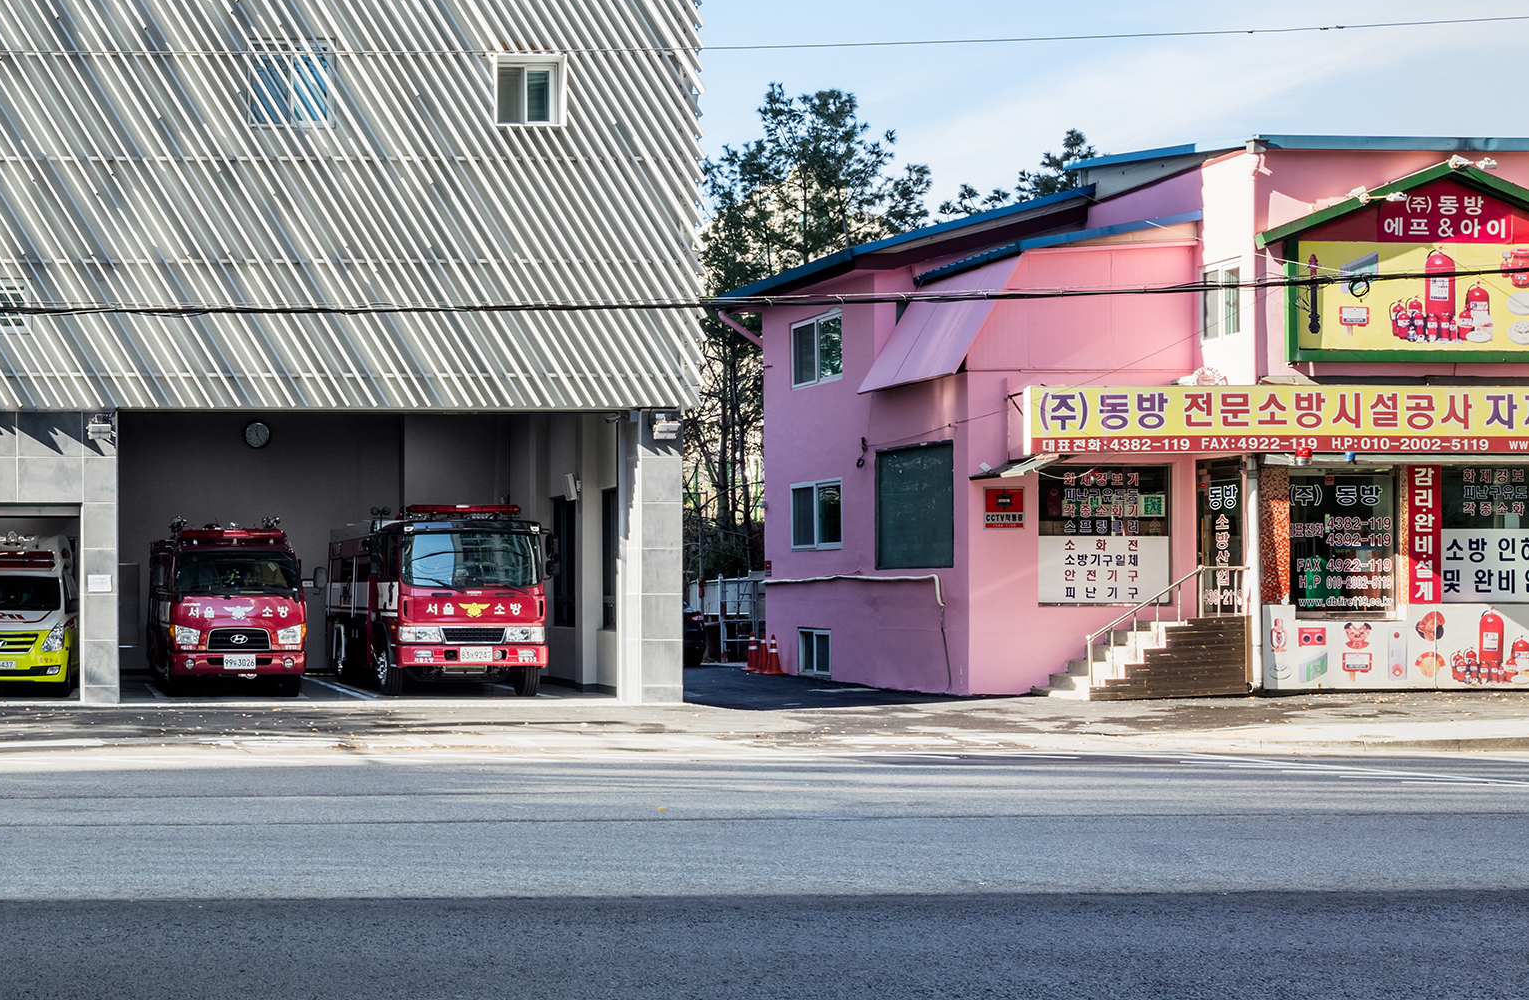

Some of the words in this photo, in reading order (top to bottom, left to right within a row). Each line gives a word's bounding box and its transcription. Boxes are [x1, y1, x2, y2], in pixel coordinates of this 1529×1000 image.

[1405, 196, 1432, 213] (주)
[1438, 195, 1484, 215] 동방
[1039, 391, 1089, 431] (주)
[1098, 391, 1169, 430] 동방
[1063, 472, 1139, 486] 화재경보기
[1463, 469, 1525, 482] 화재경보
[1064, 488, 1138, 502] 피난구유도등
[1209, 484, 1238, 510] 동방
[1289, 484, 1323, 506] (주)
[1335, 485, 1383, 506] 동방
[1463, 485, 1528, 499] 피난구유도
[1064, 504, 1139, 518] 각종소화기
[1463, 502, 1525, 516] 각종소화
[1064, 520, 1139, 534] 스프링클러
[1327, 516, 1392, 530] 4382-119
[1326, 533, 1392, 546] 4392-119
[1445, 538, 1487, 563] 소방
[1064, 554, 1138, 567] 소방기구일체
[1297, 558, 1321, 572] FAX
[1326, 558, 1392, 572] 4922-119
[1064, 569, 1138, 582] 안전기구
[1326, 575, 1392, 589] 010-2002-5119
[1443, 569, 1460, 593] 및
[1474, 569, 1515, 594] 완비
[1065, 587, 1138, 599] 피난기구
[1204, 589, 1242, 605] 439-219
[188, 606, 215, 618] 서울
[262, 606, 289, 618] 소방
[426, 603, 454, 615] 서울
[494, 603, 522, 615] 소방
